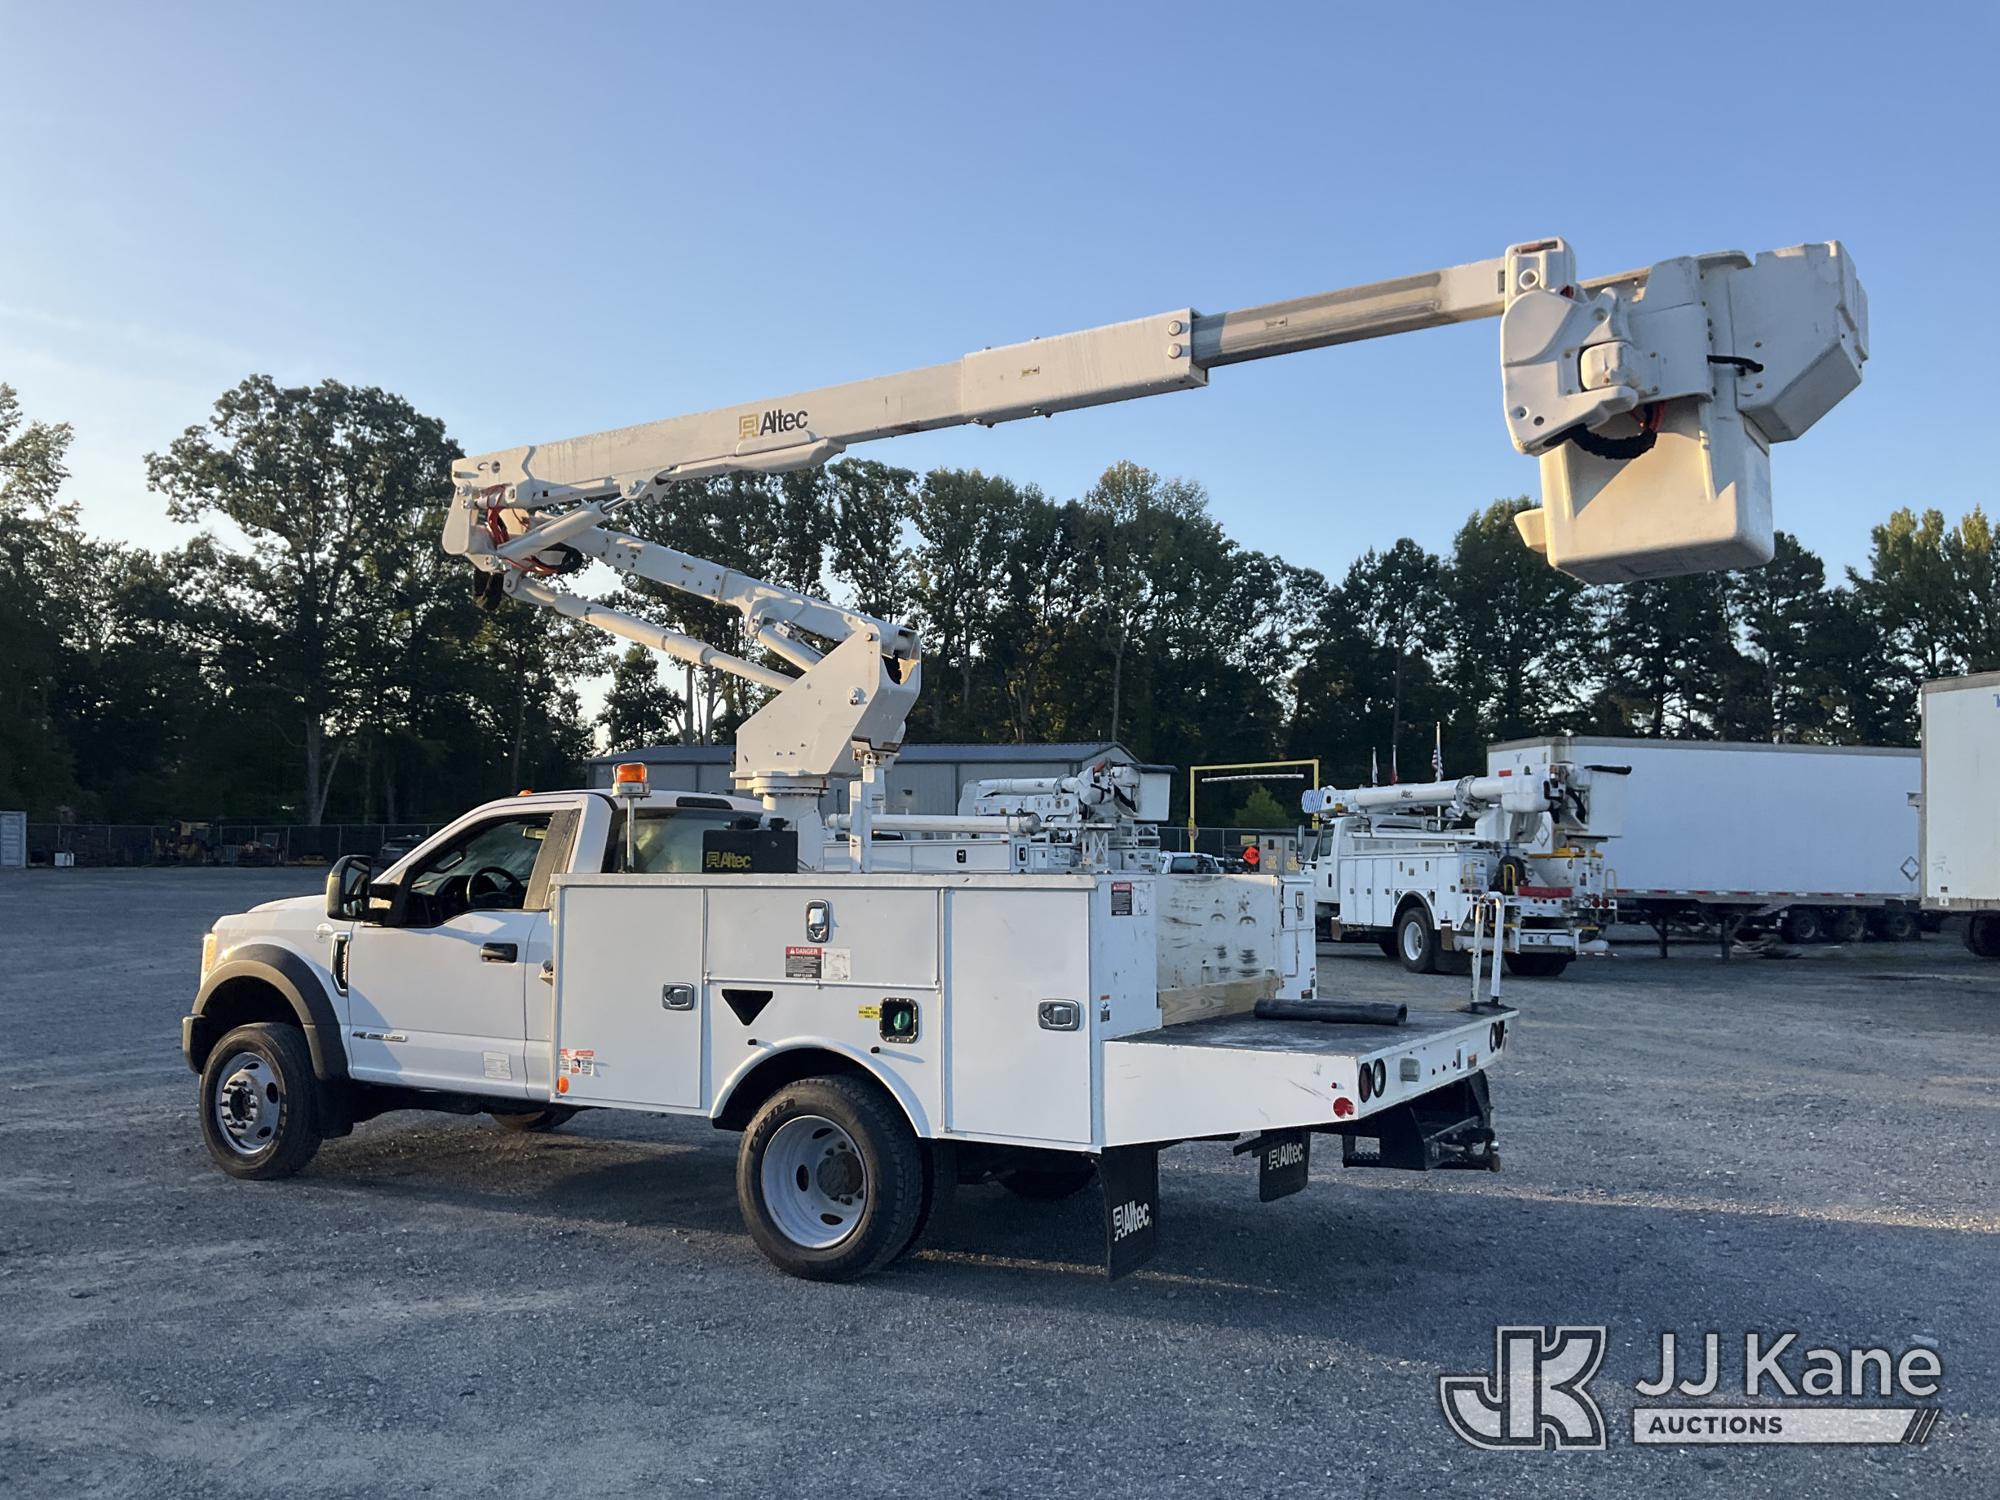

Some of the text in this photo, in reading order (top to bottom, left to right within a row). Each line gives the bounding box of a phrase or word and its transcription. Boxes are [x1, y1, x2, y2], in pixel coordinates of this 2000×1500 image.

[760, 409, 808, 436] Altec
[720, 851, 752, 868] Altec
[1279, 1142, 1303, 1167] Altec
[1124, 1201, 1150, 1236] Altec
